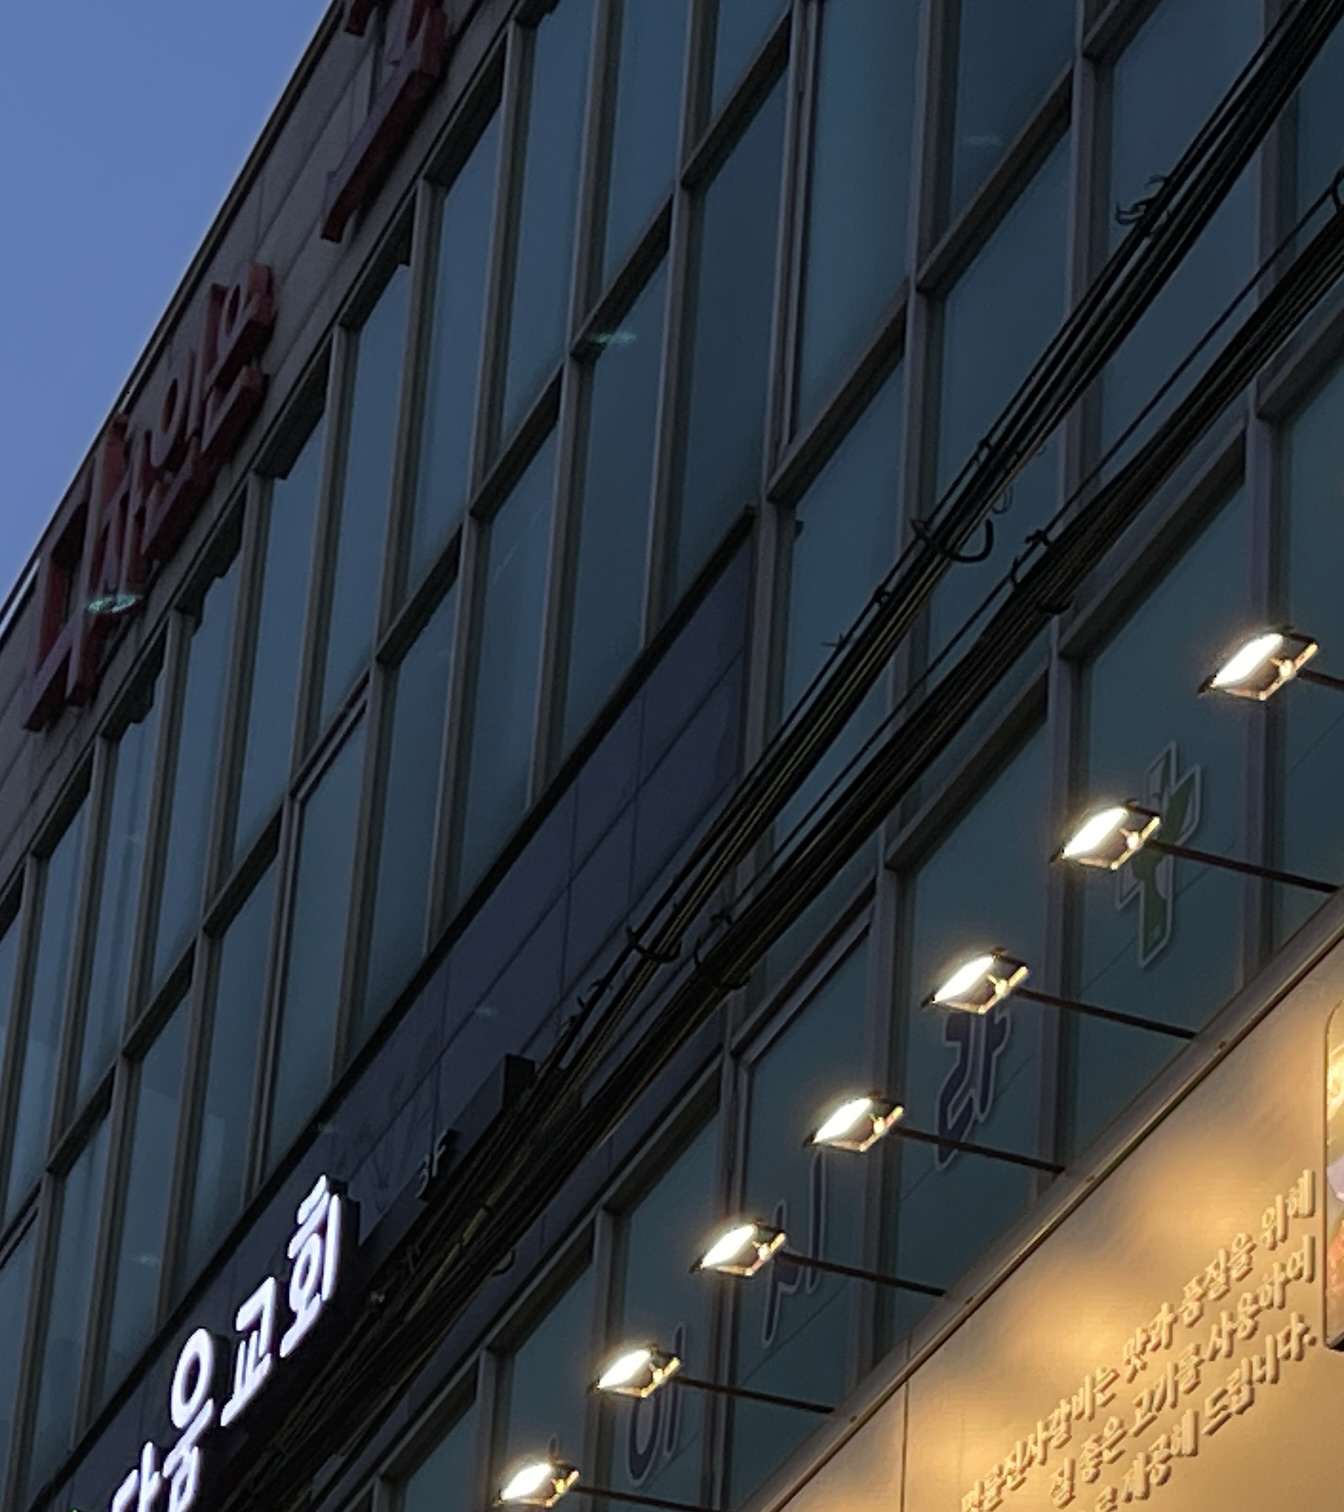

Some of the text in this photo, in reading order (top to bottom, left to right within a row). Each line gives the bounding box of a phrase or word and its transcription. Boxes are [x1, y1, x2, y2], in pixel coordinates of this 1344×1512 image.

[1048, 1235, 1316, 1507] 질 좋은 고기를 사용하여
[1122, 1301, 1178, 1385] 맛과
[1178, 1232, 1256, 1326] 품질을
[1261, 1169, 1316, 1250] 위해
[1125, 1413, 1200, 1503] 제공해
[1203, 1311, 1319, 1438] 드립니다.
